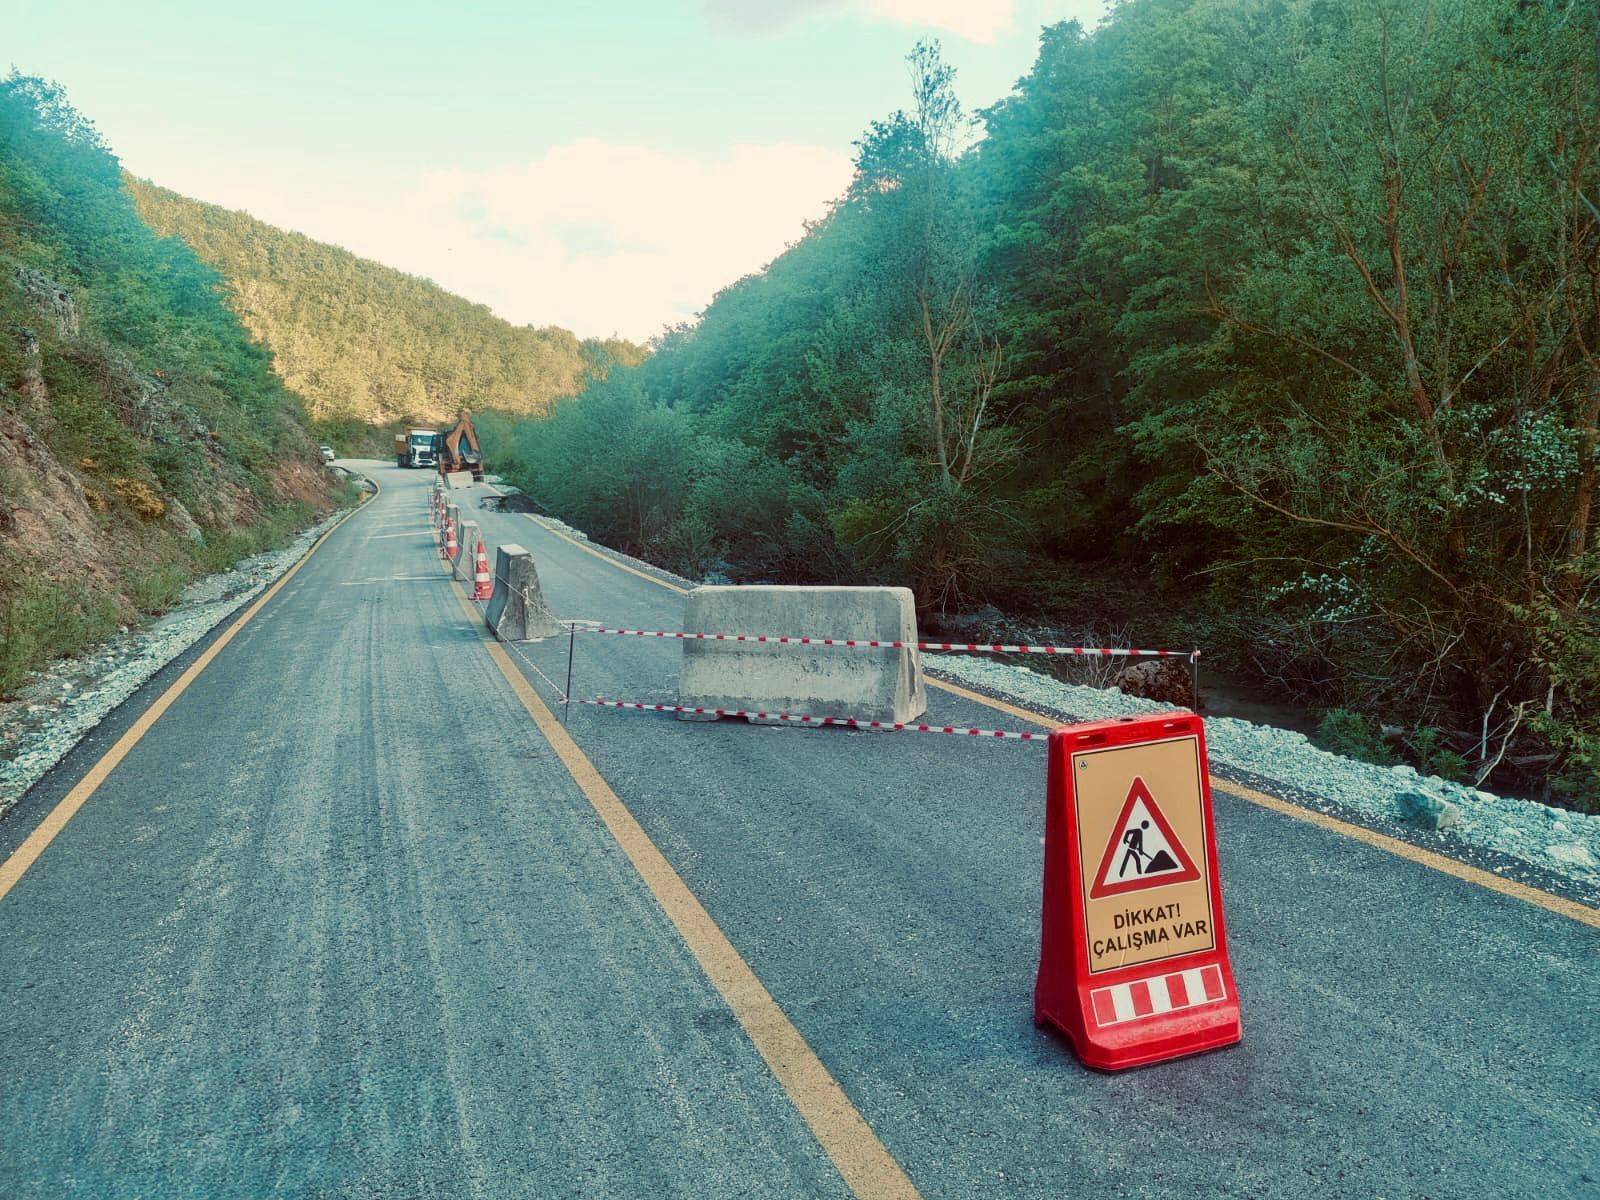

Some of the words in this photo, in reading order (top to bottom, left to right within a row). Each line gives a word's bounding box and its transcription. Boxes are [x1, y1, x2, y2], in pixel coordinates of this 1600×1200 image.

[1113, 903, 1181, 930] DİKKAT!
[1093, 927, 1170, 958] ÇALIŞMA
[1172, 920, 1208, 939] VAR
